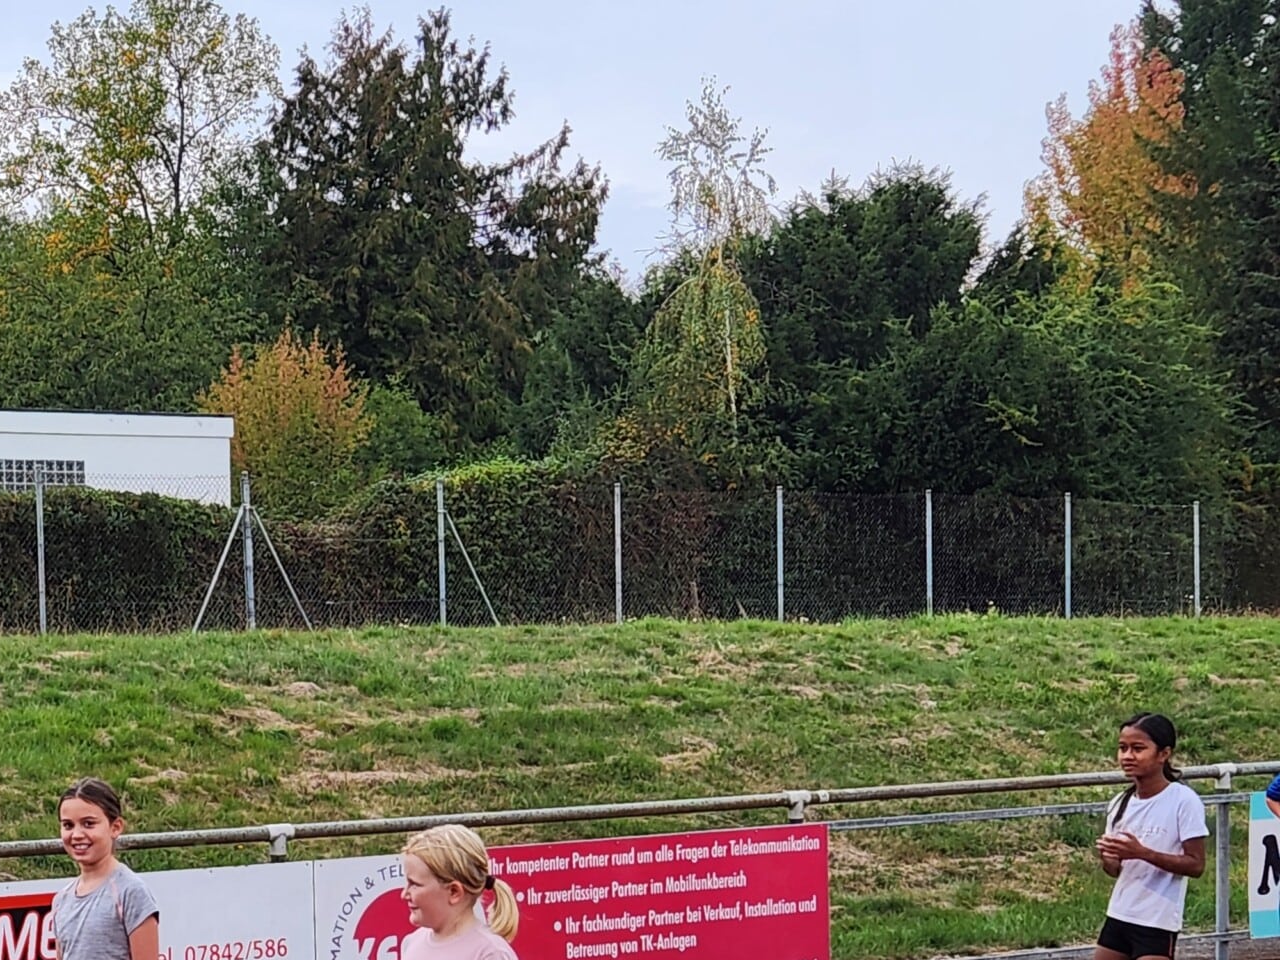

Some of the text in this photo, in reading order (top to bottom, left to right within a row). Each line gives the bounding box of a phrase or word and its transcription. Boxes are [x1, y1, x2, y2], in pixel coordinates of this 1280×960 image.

[506, 855, 570, 877] kompetenter
[572, 852, 609, 869] Partner
[612, 846, 635, 865] rund
[637, 849, 653, 864] um
[655, 844, 674, 862] alle
[676, 843, 709, 863] Fragen
[711, 840, 728, 858] der
[729, 835, 820, 857] Telekommunikation
[365, 876, 375, 890] &
[527, 869, 747, 905] Ihr zuverlässiger Partner im Mobilfunkbereich
[565, 894, 817, 934] Ihr fachkundiger Partner bei Verkauf, Installation und
[566, 932, 697, 959] Betreuung von TK-Anlagen
